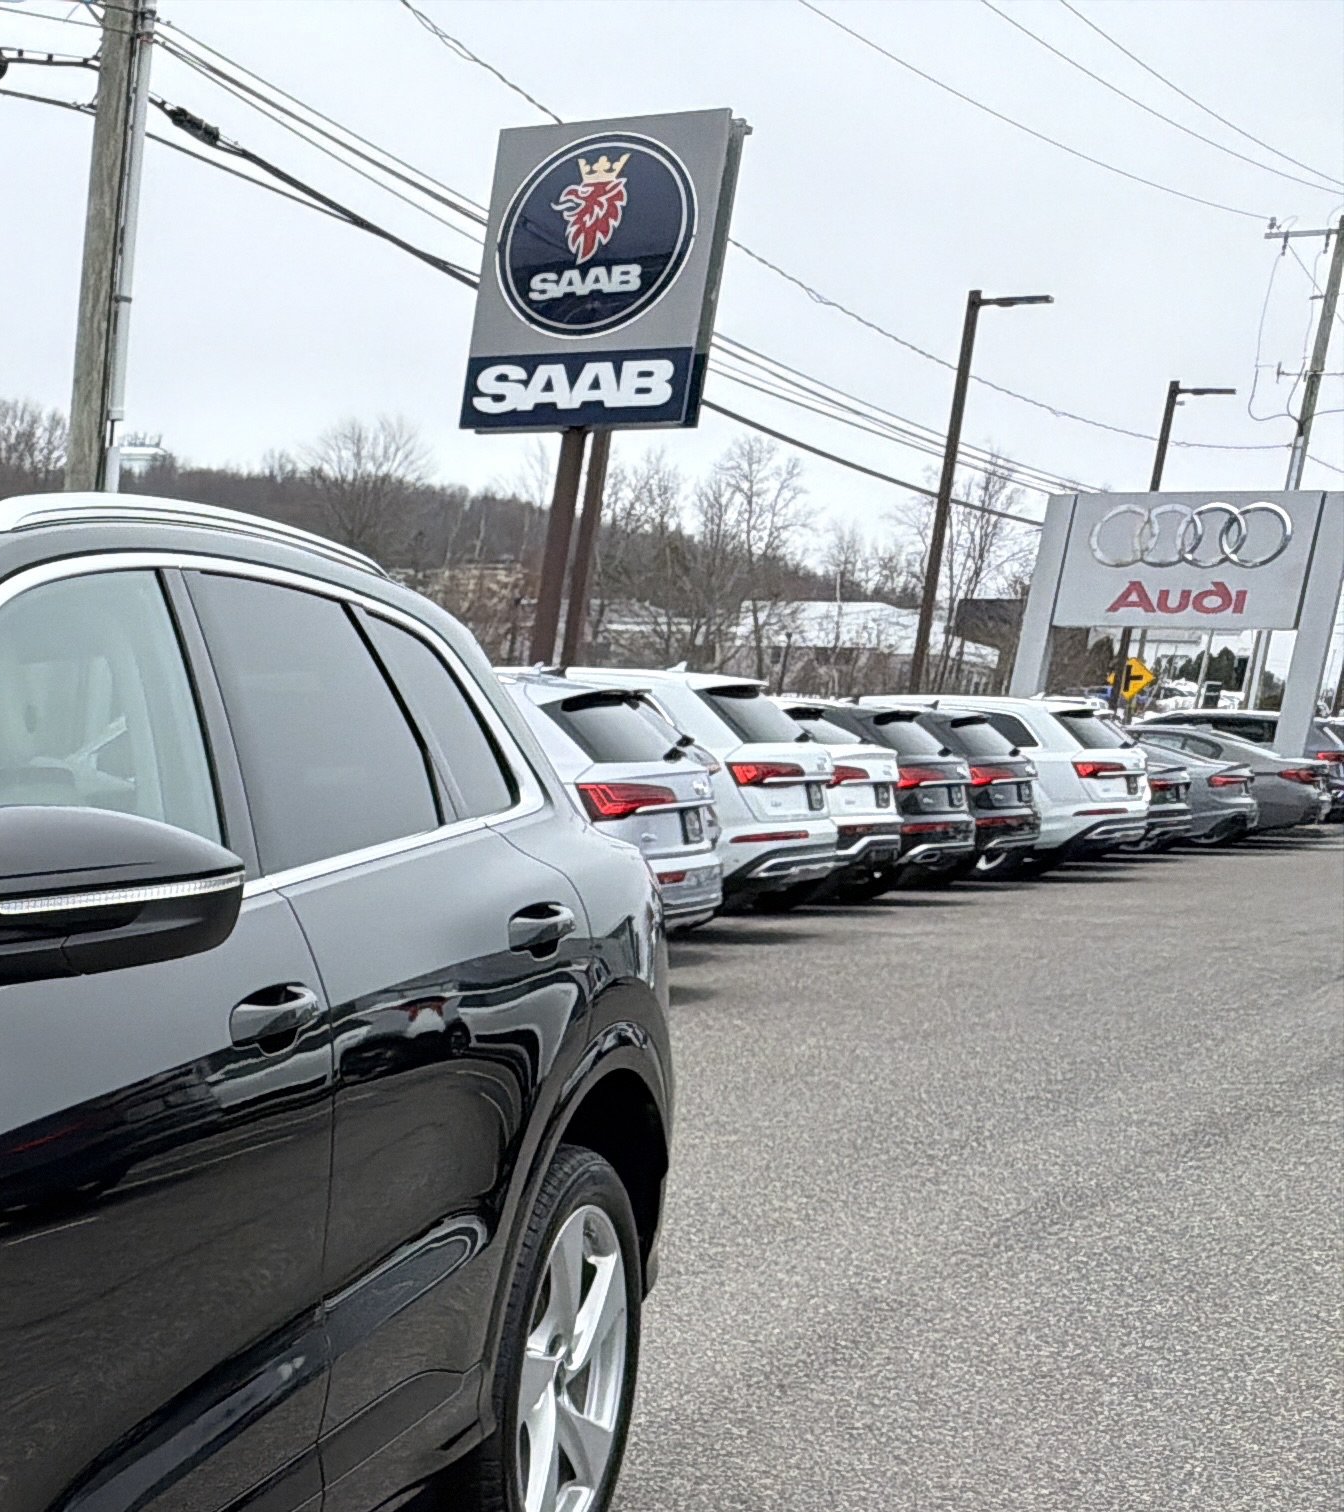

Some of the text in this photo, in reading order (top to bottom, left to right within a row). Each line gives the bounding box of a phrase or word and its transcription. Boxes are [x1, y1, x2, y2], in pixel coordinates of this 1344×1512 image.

[527, 263, 642, 302] SAAB
[471, 358, 675, 415] SAAB
[1105, 580, 1248, 616] Audi
